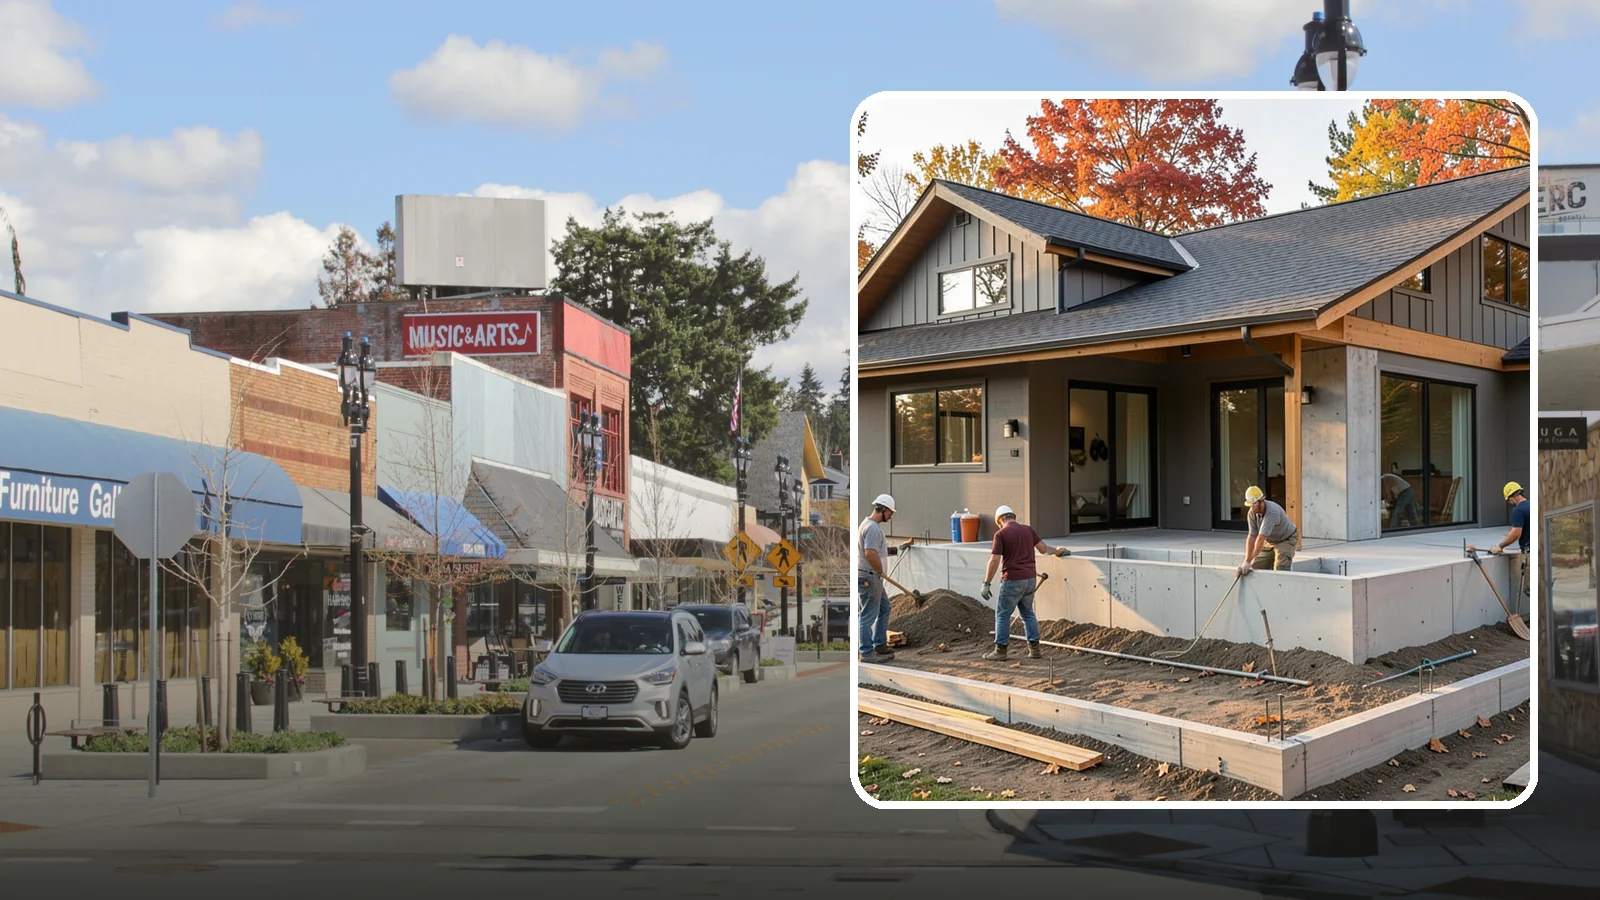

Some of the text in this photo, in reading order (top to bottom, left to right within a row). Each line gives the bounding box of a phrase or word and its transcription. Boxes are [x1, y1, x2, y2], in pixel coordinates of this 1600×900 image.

[1538, 181, 1586, 213] ERC
[408, 322, 520, 348] MUSIC&ARTS
[1540, 427, 1577, 437] UGA
[0, 471, 122, 519] Furniture Gal
